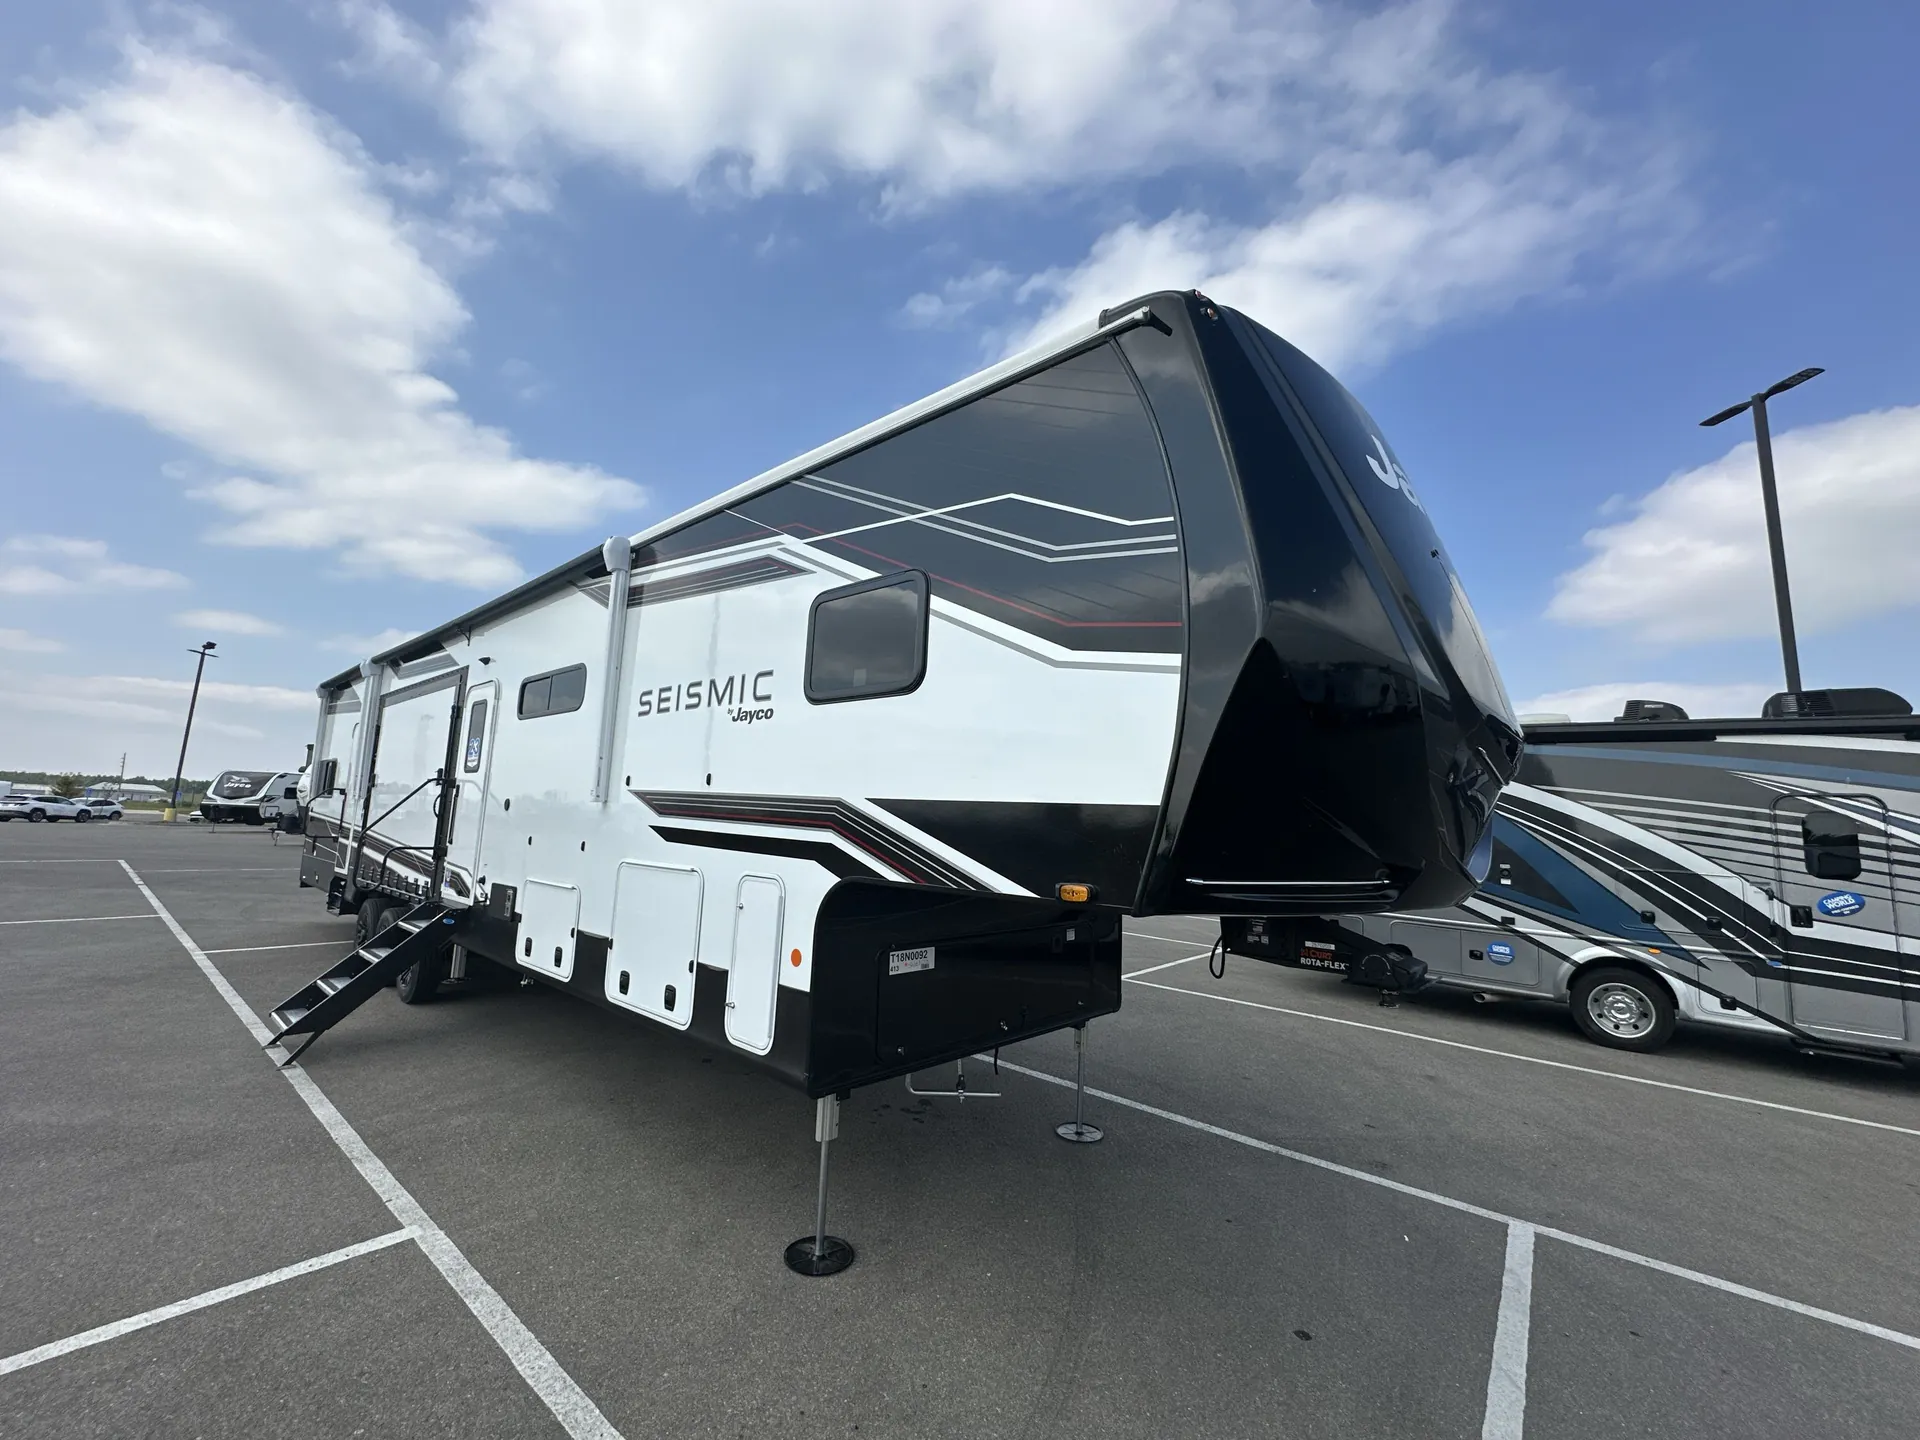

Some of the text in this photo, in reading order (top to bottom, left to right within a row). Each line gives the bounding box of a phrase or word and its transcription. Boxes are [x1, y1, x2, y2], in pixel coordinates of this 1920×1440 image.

[1366, 434, 1427, 516] Ja
[638, 669, 774, 717] SEISMIC
[727, 707, 774, 724] by Jayco
[1827, 898, 1855, 909] WORLD
[890, 949, 928, 963] T18N0092
